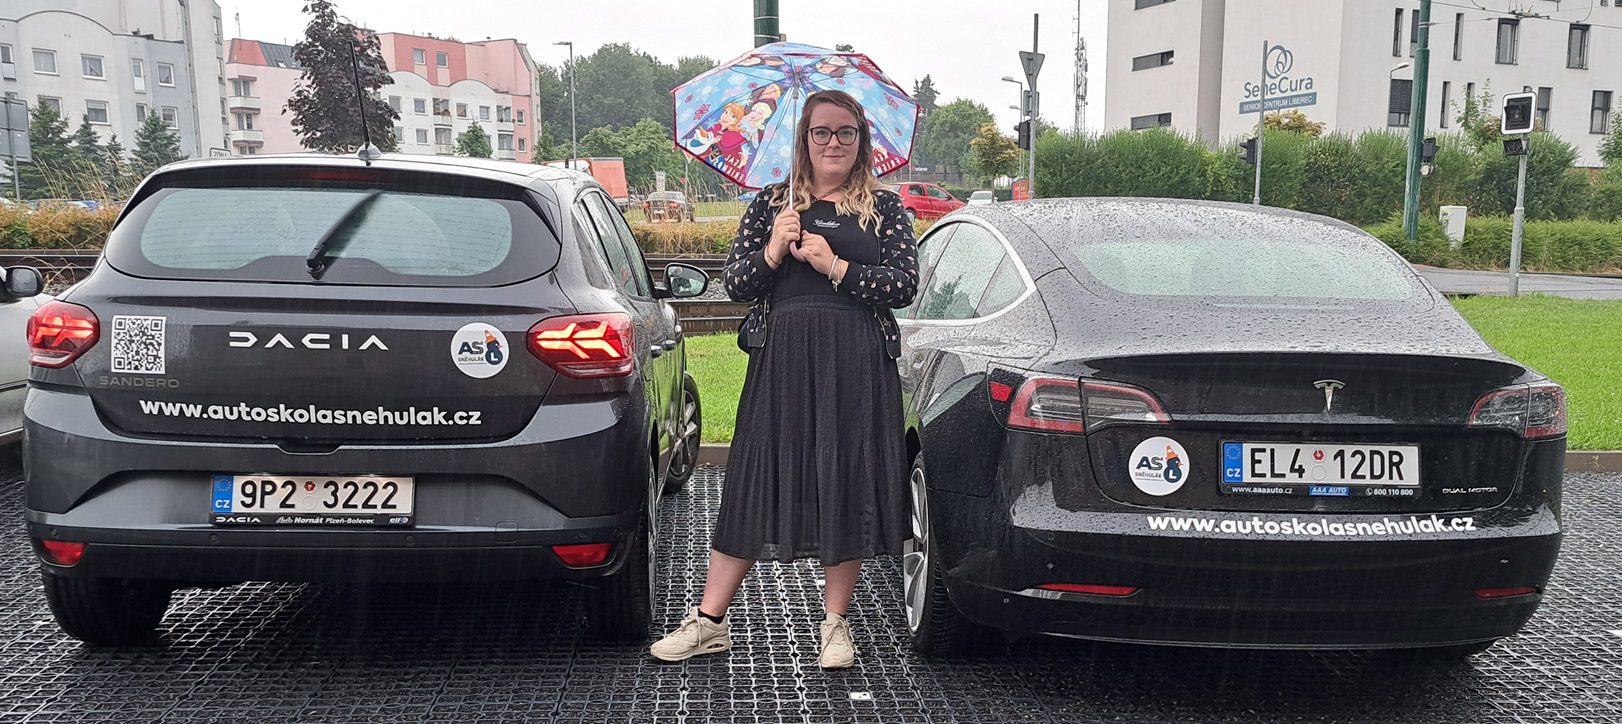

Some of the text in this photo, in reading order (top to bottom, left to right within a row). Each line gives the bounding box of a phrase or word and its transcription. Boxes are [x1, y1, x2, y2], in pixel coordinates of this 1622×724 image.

[1244, 78, 1313, 98] SeneCura
[228, 330, 389, 352] DACIA
[458, 341, 484, 355] AS
[99, 375, 180, 389] SANDERO
[139, 398, 482, 426] www.autoskolasnehulak.cz
[1136, 456, 1163, 471] AS
[1250, 448, 1404, 480] EL4 12DR
[1226, 468, 1241, 478] CZ
[240, 480, 398, 509] 9P2 3222
[1232, 486, 1293, 494] www.aaaauto.cz
[1312, 486, 1347, 494] AAA AUTO
[1373, 488, 1413, 496] 800 110 800
[215, 499, 231, 509] CZ
[294, 516, 323, 524] Hornát
[1147, 514, 1476, 536] www.autoskolasnehulak.cz
